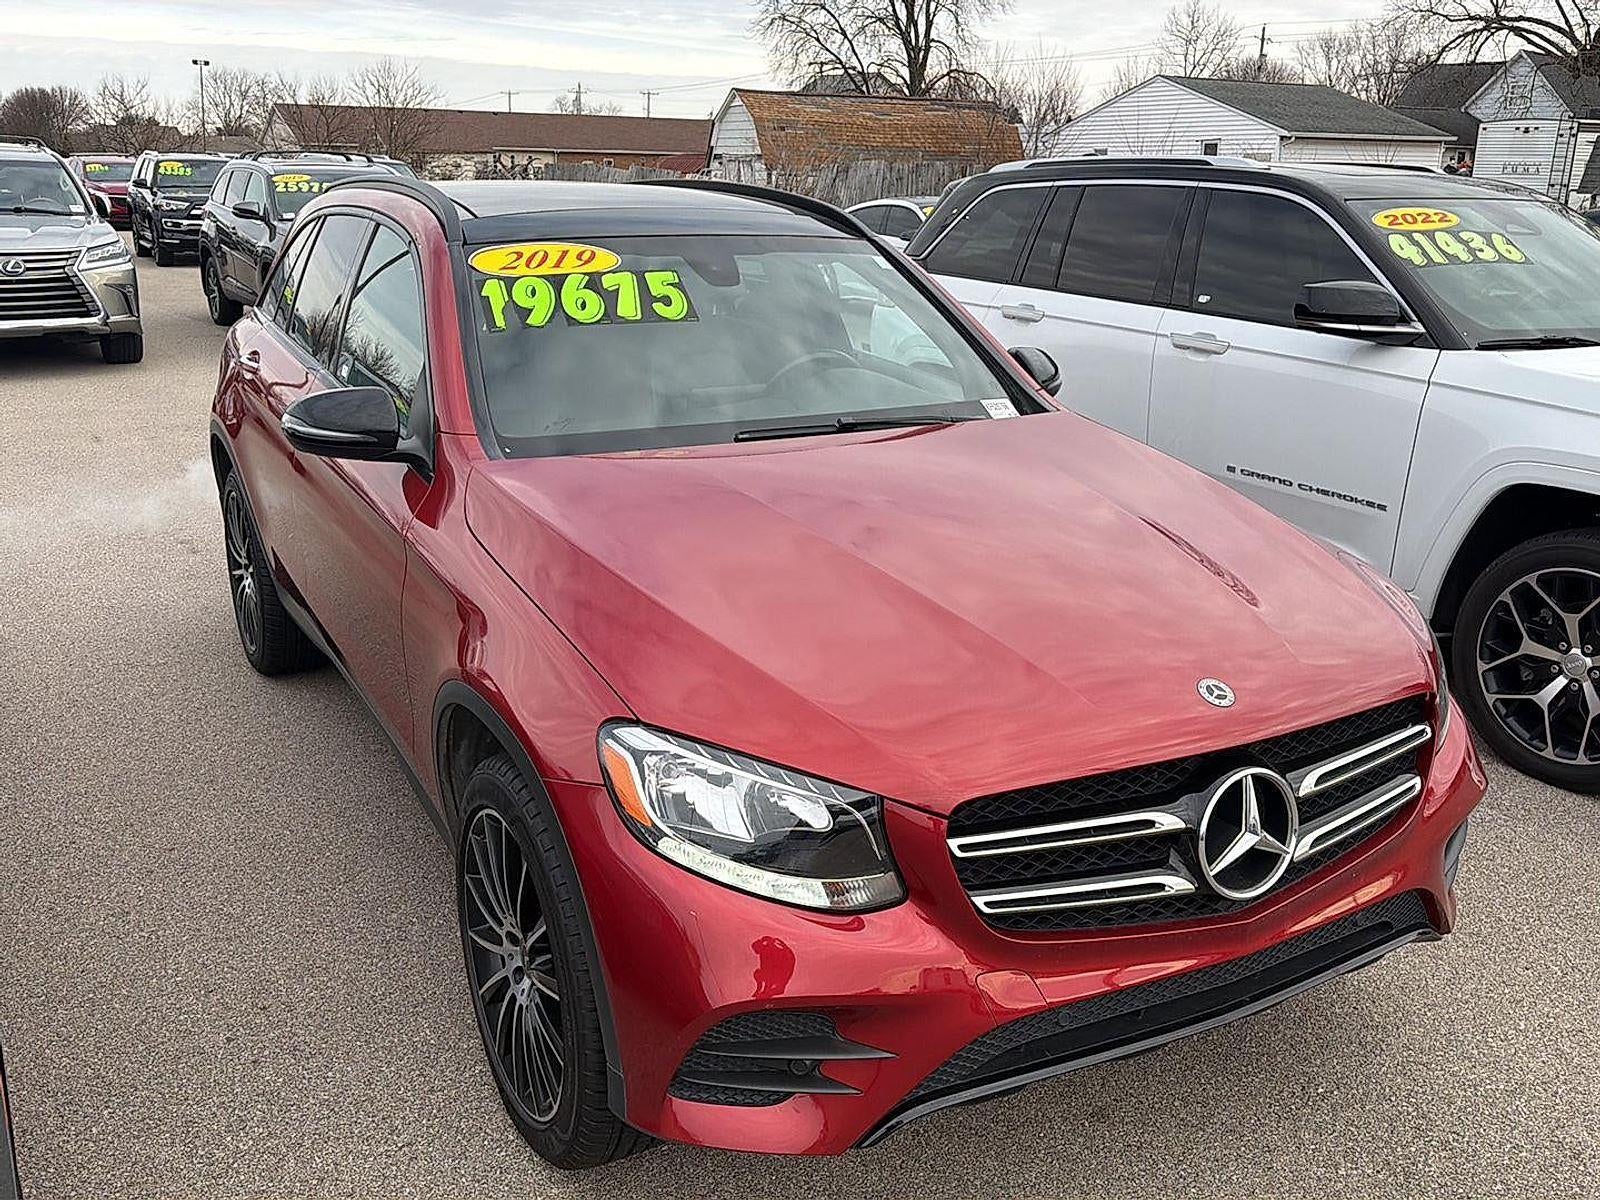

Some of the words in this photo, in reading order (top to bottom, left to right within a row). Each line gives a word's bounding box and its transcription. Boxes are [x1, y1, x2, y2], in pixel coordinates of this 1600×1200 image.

[1384, 212, 1452, 226] 2022
[499, 249, 597, 270] 2019
[1388, 231, 1526, 266] 41436
[481, 271, 689, 330] 19675
[1240, 468, 1293, 487] GRAND
[1298, 483, 1388, 512] CHEROKEE
